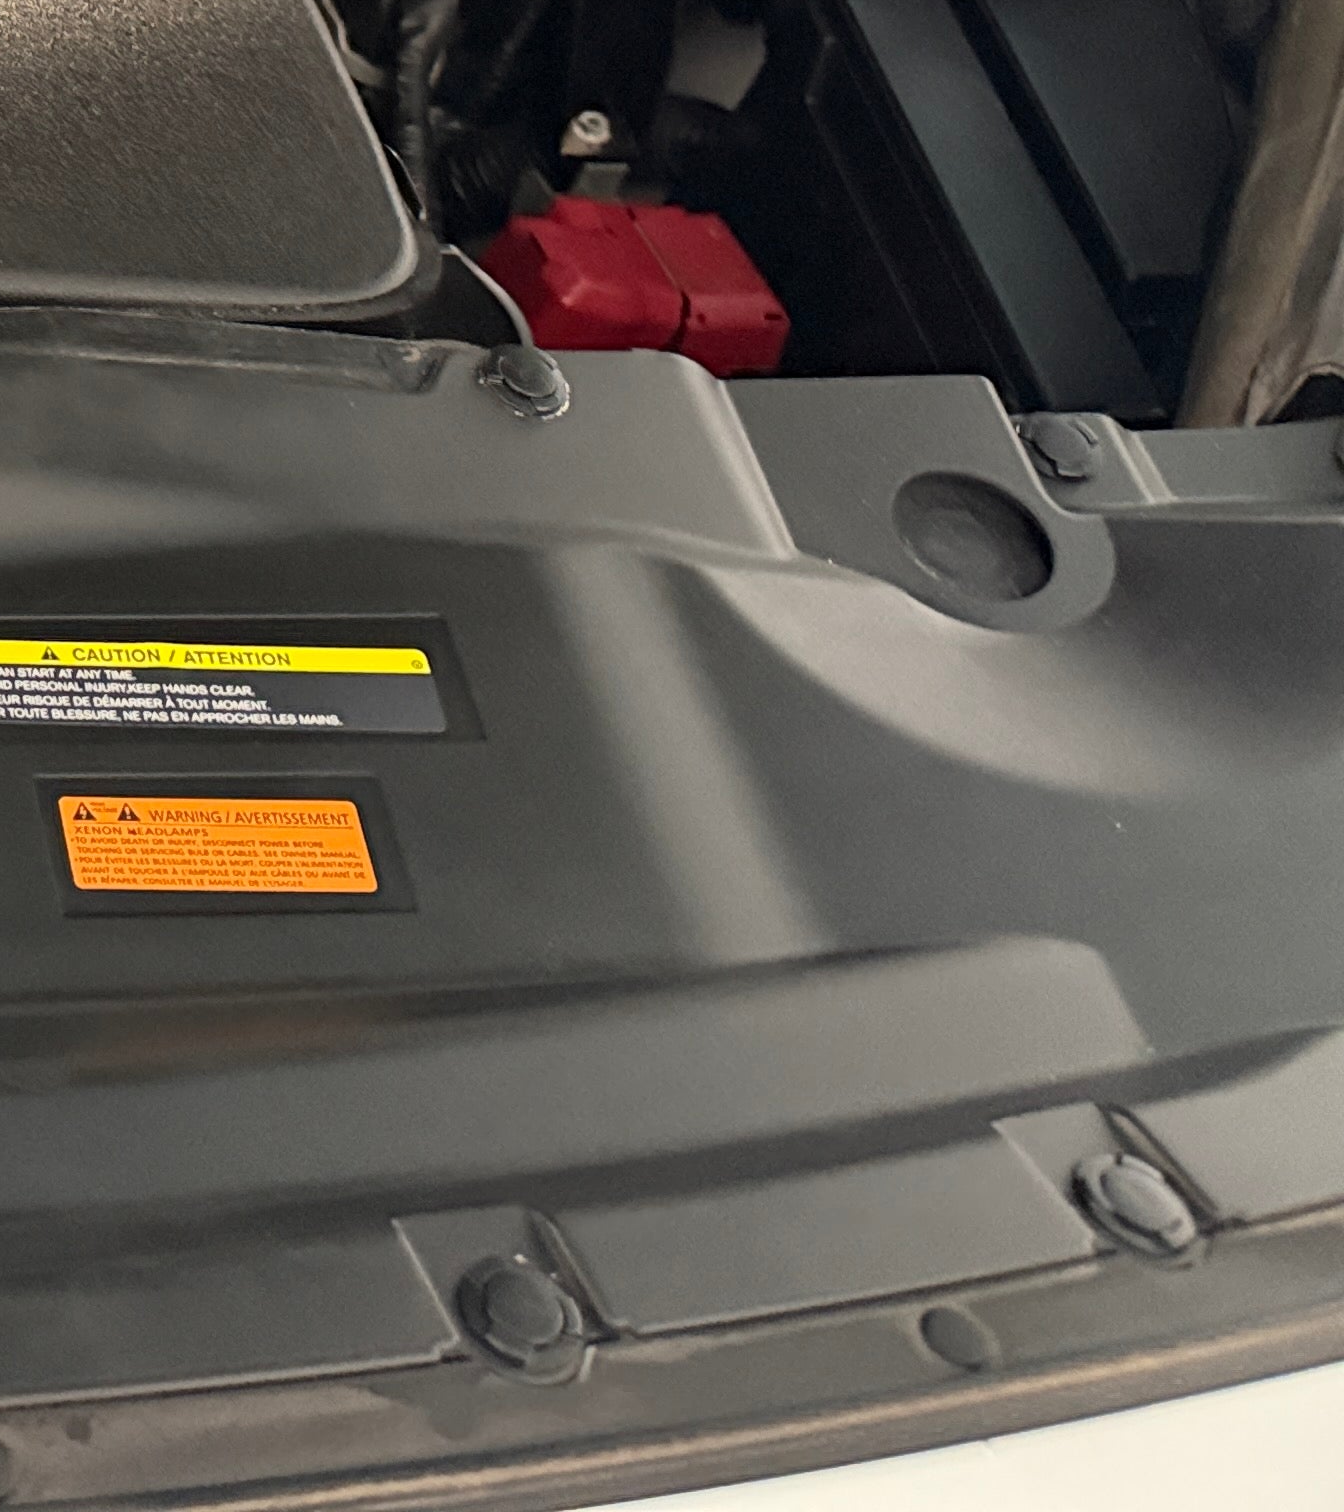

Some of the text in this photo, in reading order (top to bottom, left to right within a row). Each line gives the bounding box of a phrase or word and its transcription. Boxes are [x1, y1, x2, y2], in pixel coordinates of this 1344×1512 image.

[72, 647, 291, 666] CAUTION / ATTENTION
[17, 668, 56, 679] START
[58, 669, 73, 679] AT
[75, 669, 102, 680] ANY
[104, 669, 136, 681] TIME.
[15, 680, 83, 692] PERSONAL
[163, 683, 208, 696] HANDS
[210, 684, 256, 697] CLEAR.
[23, 694, 71, 707] RISQUE
[73, 696, 92, 707] DE
[93, 694, 163, 709] DÉMARRER
[165, 694, 177, 708] À
[179, 698, 210, 710] TOUT
[212, 699, 272, 712] MOMENT.
[8, 707, 50, 719] TOUTE
[123, 710, 141, 722] NE
[143, 711, 169, 723] PAS
[171, 712, 189, 723] EN
[191, 712, 272, 725] APPROCHER
[273, 714, 297, 726] LES
[299, 714, 344, 727] MAINS.
[148, 809, 222, 824] WARNING
[234, 811, 350, 826] AVERTISSEMENT
[74, 825, 209, 837] XENON HEADLAMPS
[75, 837, 88, 845] TO
[90, 837, 118, 845] AVOID
[120, 837, 149, 846] DEATH
[76, 846, 123, 855] TOUCHING
[78, 856, 103, 864] POUR
